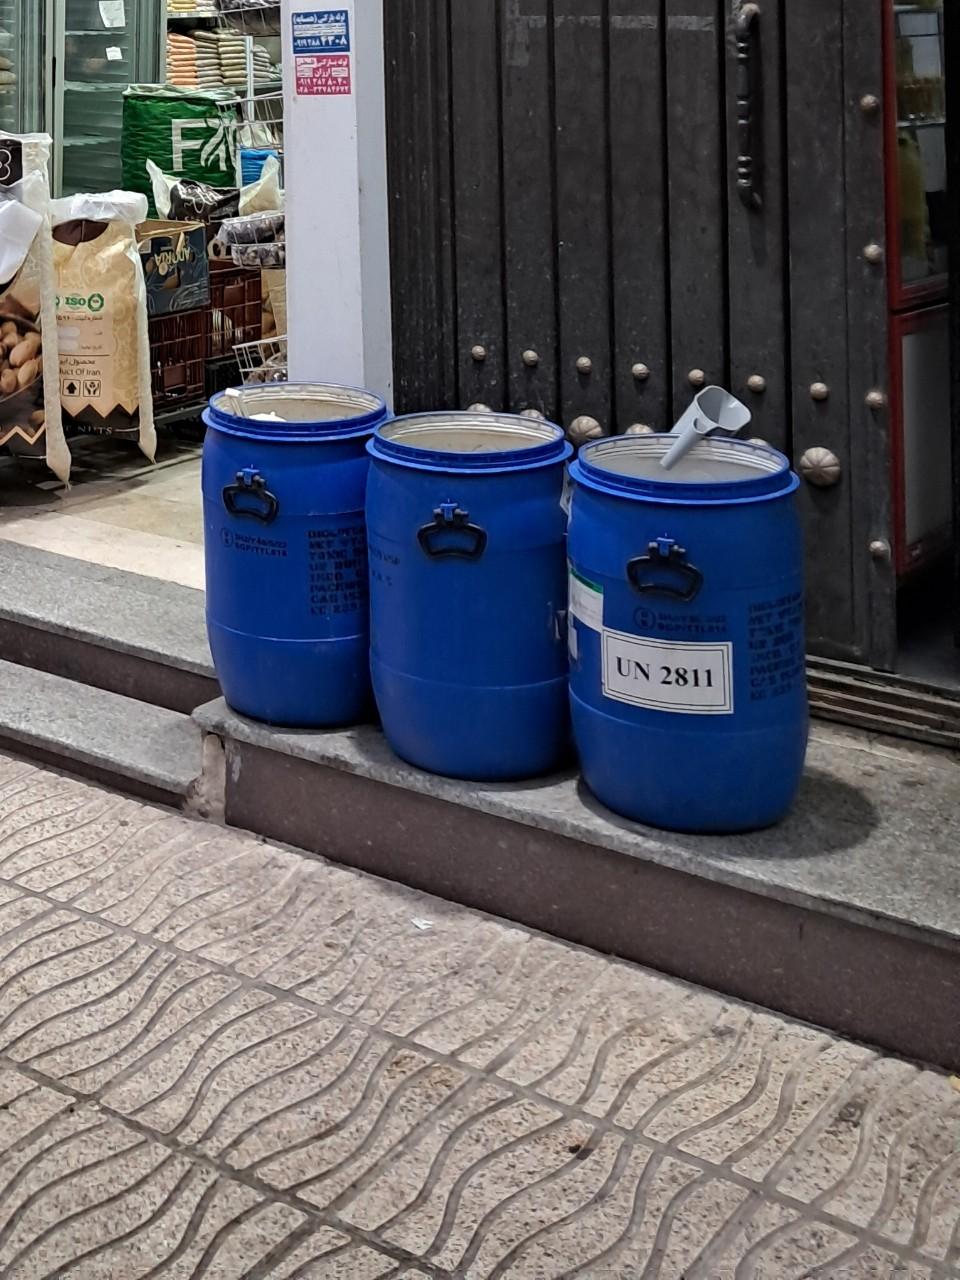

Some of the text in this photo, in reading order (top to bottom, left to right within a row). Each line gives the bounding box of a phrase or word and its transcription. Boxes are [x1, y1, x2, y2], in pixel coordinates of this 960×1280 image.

[65, 296, 86, 306] ISO
[86, 368, 101, 376] Iran
[616, 656, 713, 688] UN 2811
